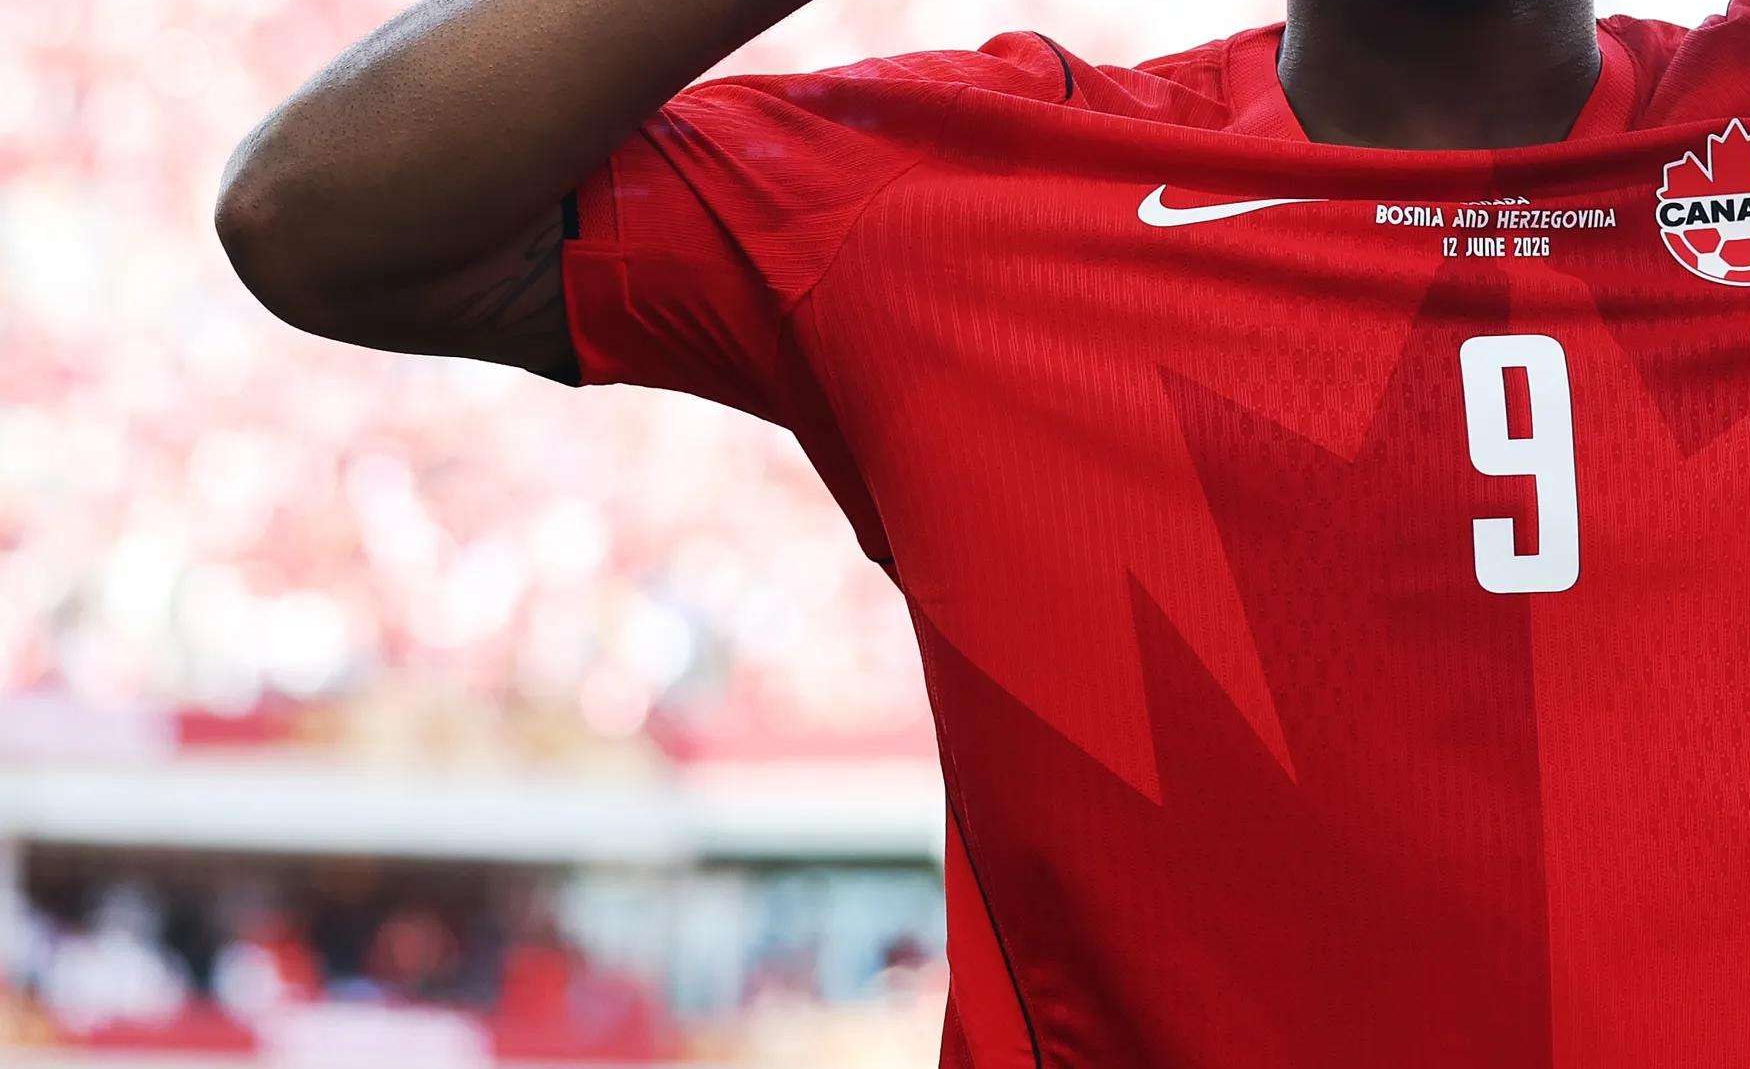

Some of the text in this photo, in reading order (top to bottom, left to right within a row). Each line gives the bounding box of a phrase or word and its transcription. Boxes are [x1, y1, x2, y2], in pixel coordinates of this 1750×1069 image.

[1375, 204, 1617, 229] BOSNIA AND HERZEGOVINA
[1442, 236, 1550, 257] 12 JUNE 2026
[1459, 334, 1580, 594] 9
